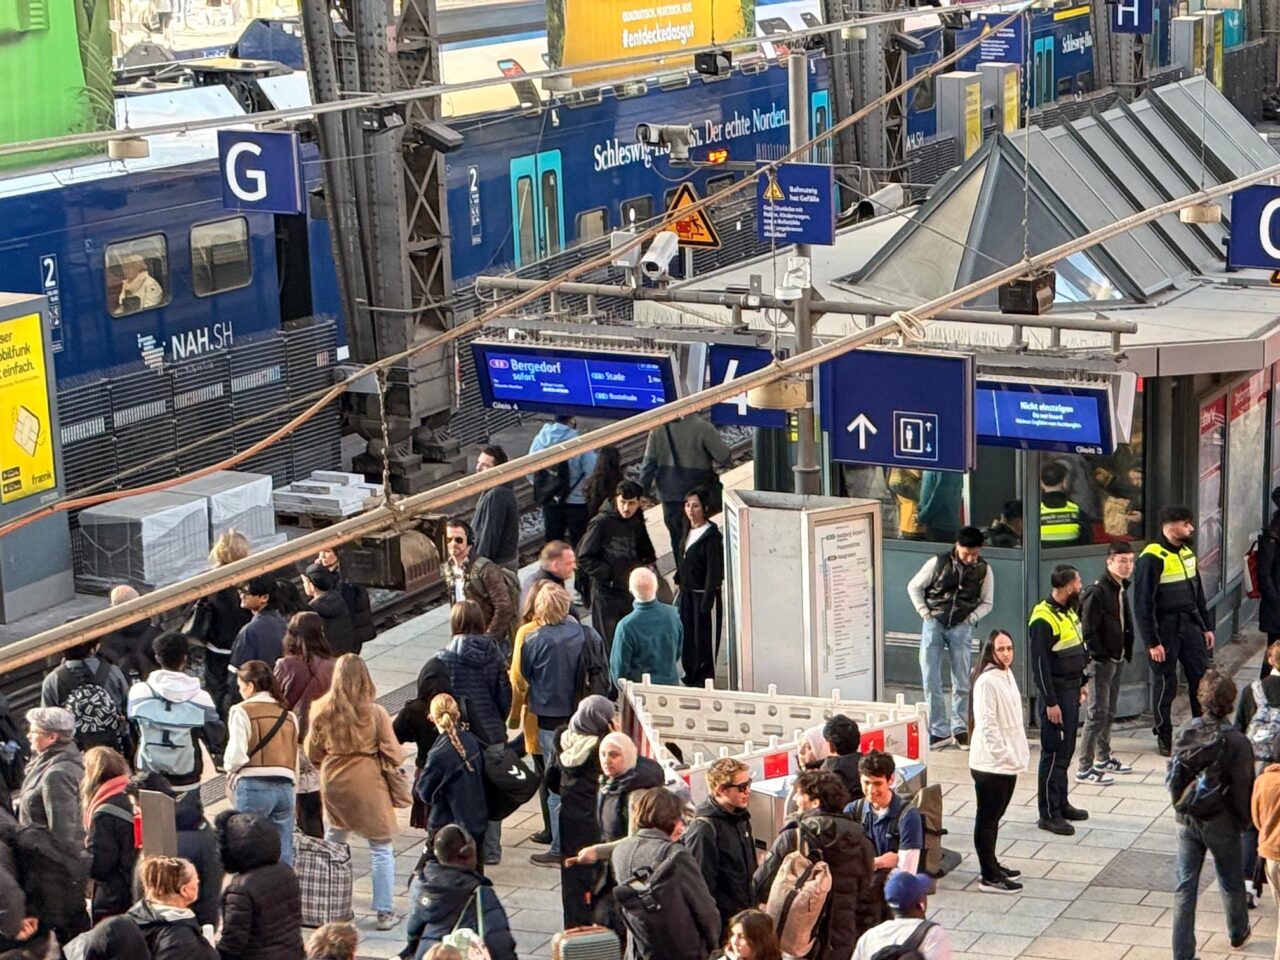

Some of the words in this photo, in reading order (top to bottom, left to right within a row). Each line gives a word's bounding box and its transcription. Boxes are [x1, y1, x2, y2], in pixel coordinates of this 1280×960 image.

[1118, 0, 1138, 26] H
[705, 119, 723, 145] Der
[725, 112, 751, 140] echte
[752, 102, 790, 134] Norden.
[226, 141, 267, 202] G
[470, 168, 478, 191] 2
[43, 258, 56, 287] 2
[171, 321, 233, 360] NAH.SH
[510, 358, 561, 374] Bergedorf
[512, 372, 536, 382] sofort
[605, 371, 626, 382] Stade
[1075, 445, 1095, 454] Gleis
